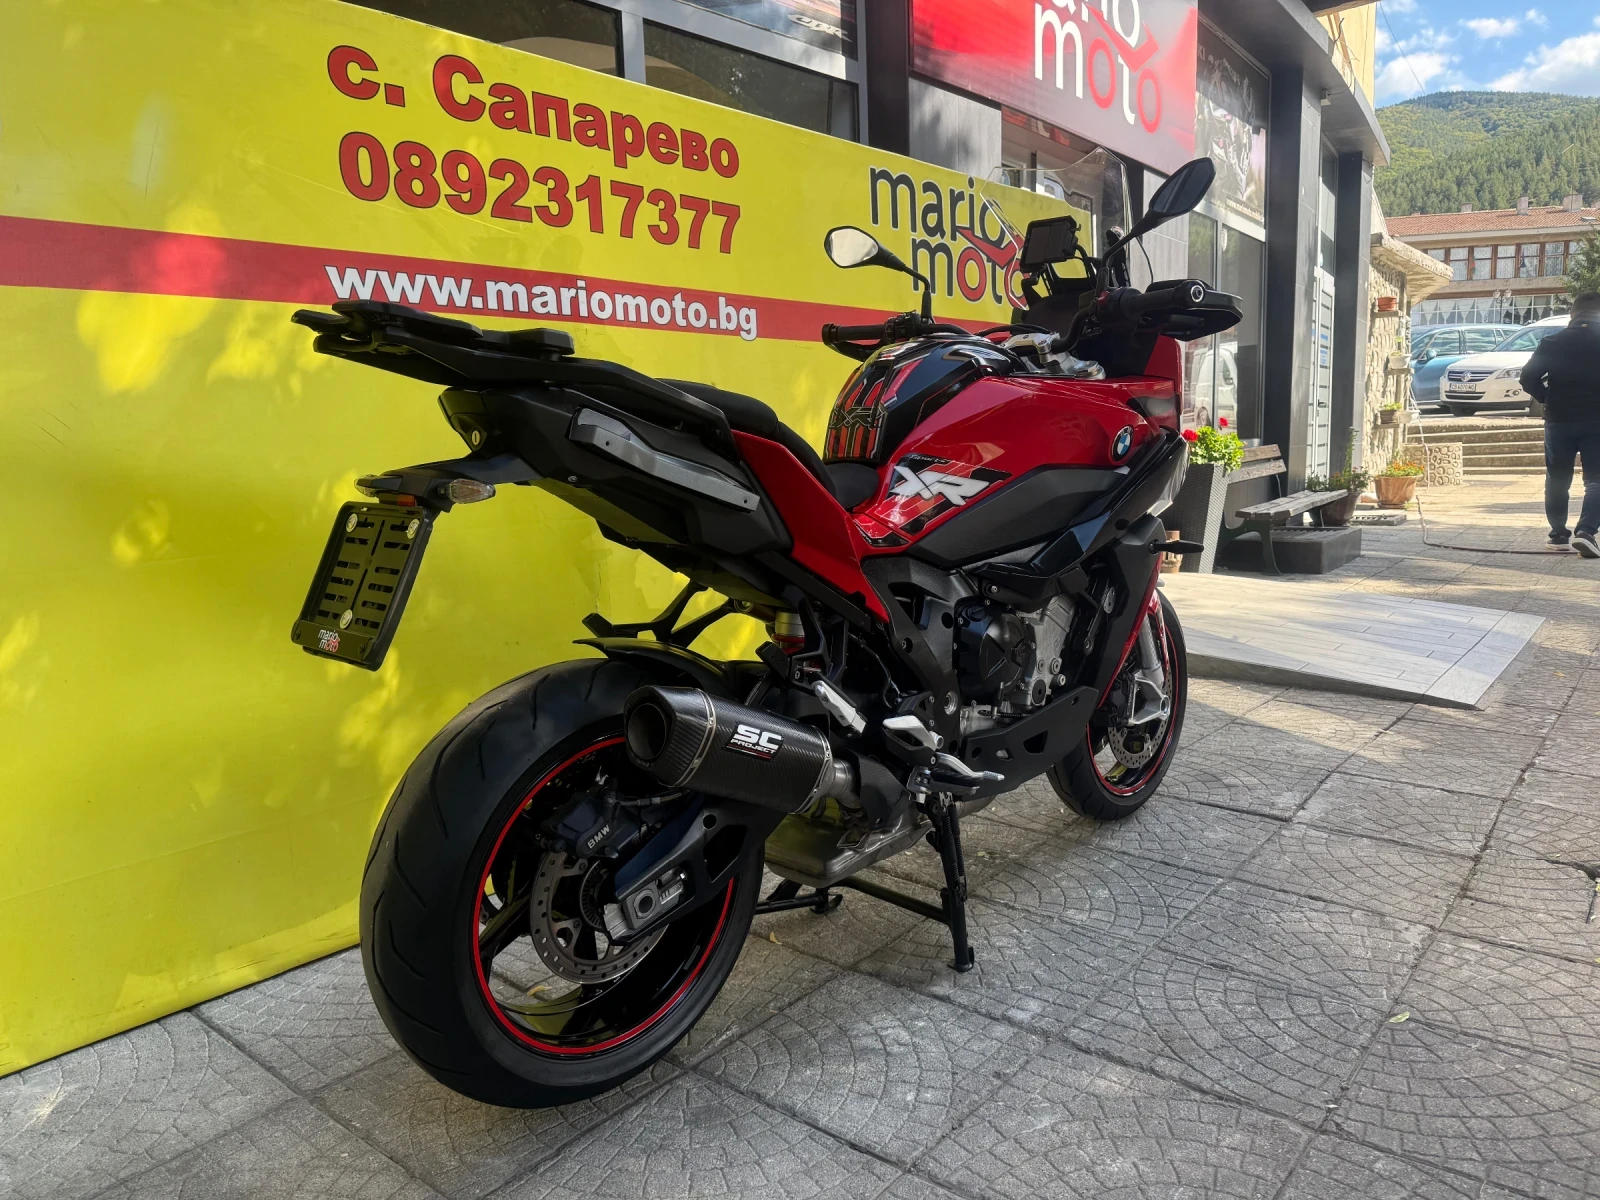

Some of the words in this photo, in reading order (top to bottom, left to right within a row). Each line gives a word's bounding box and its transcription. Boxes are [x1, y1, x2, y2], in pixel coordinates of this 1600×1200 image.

[1034, 2, 1163, 134] moto
[432, 54, 740, 178] Сапарево
[338, 131, 741, 254] 0892317377
[869, 165, 1007, 250] mario
[324, 265, 758, 341] www.mariomoto.bg
[911, 237, 1031, 309] moto
[889, 465, 990, 506] XR
[730, 738, 777, 754] PROJECT
[733, 723, 782, 750] SC
[587, 824, 610, 849] BMW
